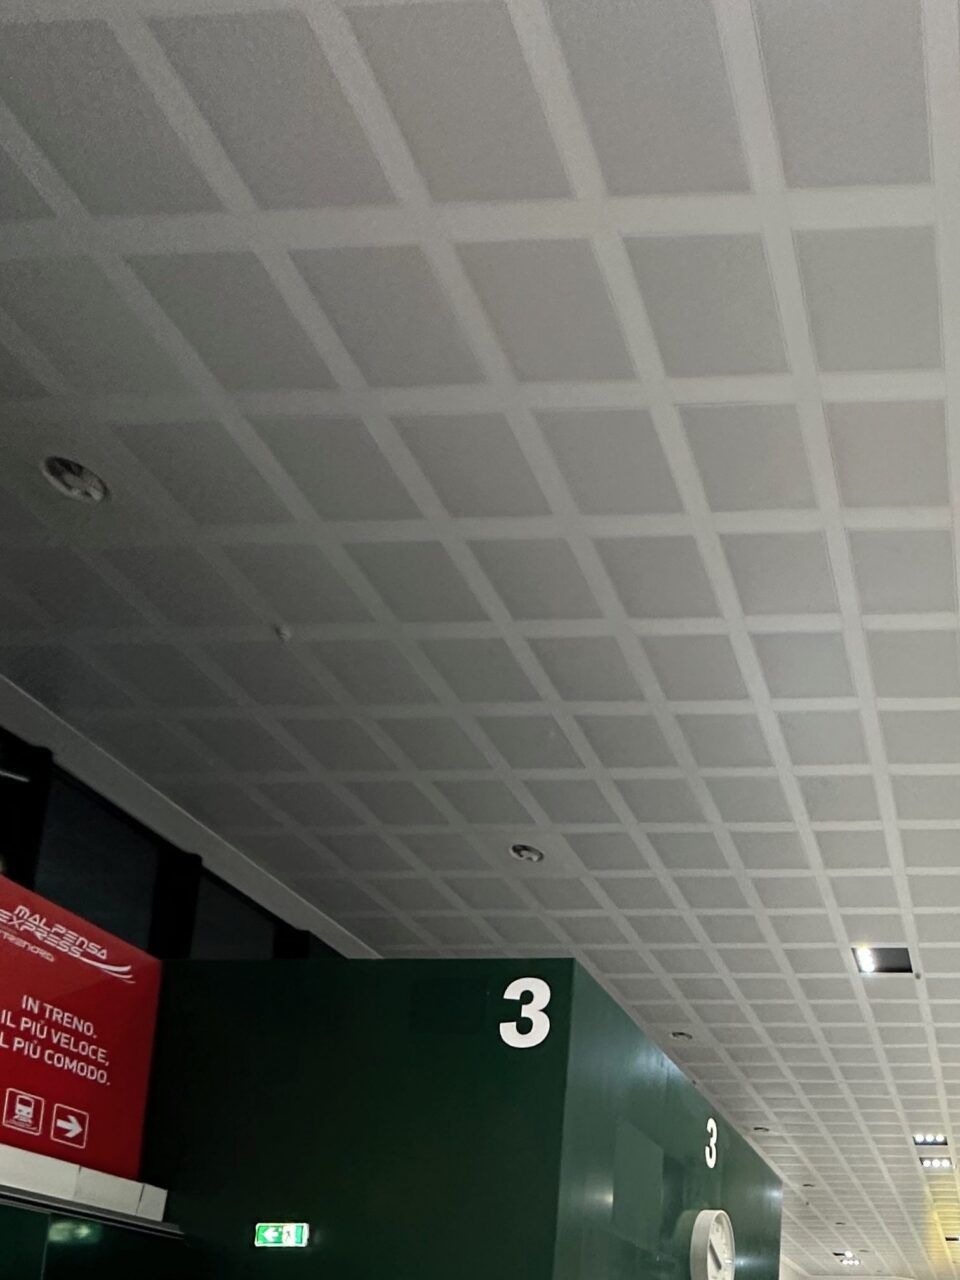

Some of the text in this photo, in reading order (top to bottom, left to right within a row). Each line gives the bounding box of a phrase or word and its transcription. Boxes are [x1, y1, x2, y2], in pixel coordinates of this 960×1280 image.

[0, 909, 84, 958] EXPRESS
[14, 905, 107, 960] MALPENSA
[0, 1009, 16, 1028] IL
[51, 1028, 109, 1066] VELOCE,
[22, 995, 97, 1038] IN TRENO.
[499, 977, 551, 1048] 3
[0, 1032, 110, 1085] L PIÙ COMODO.
[705, 1117, 717, 1169] 3
